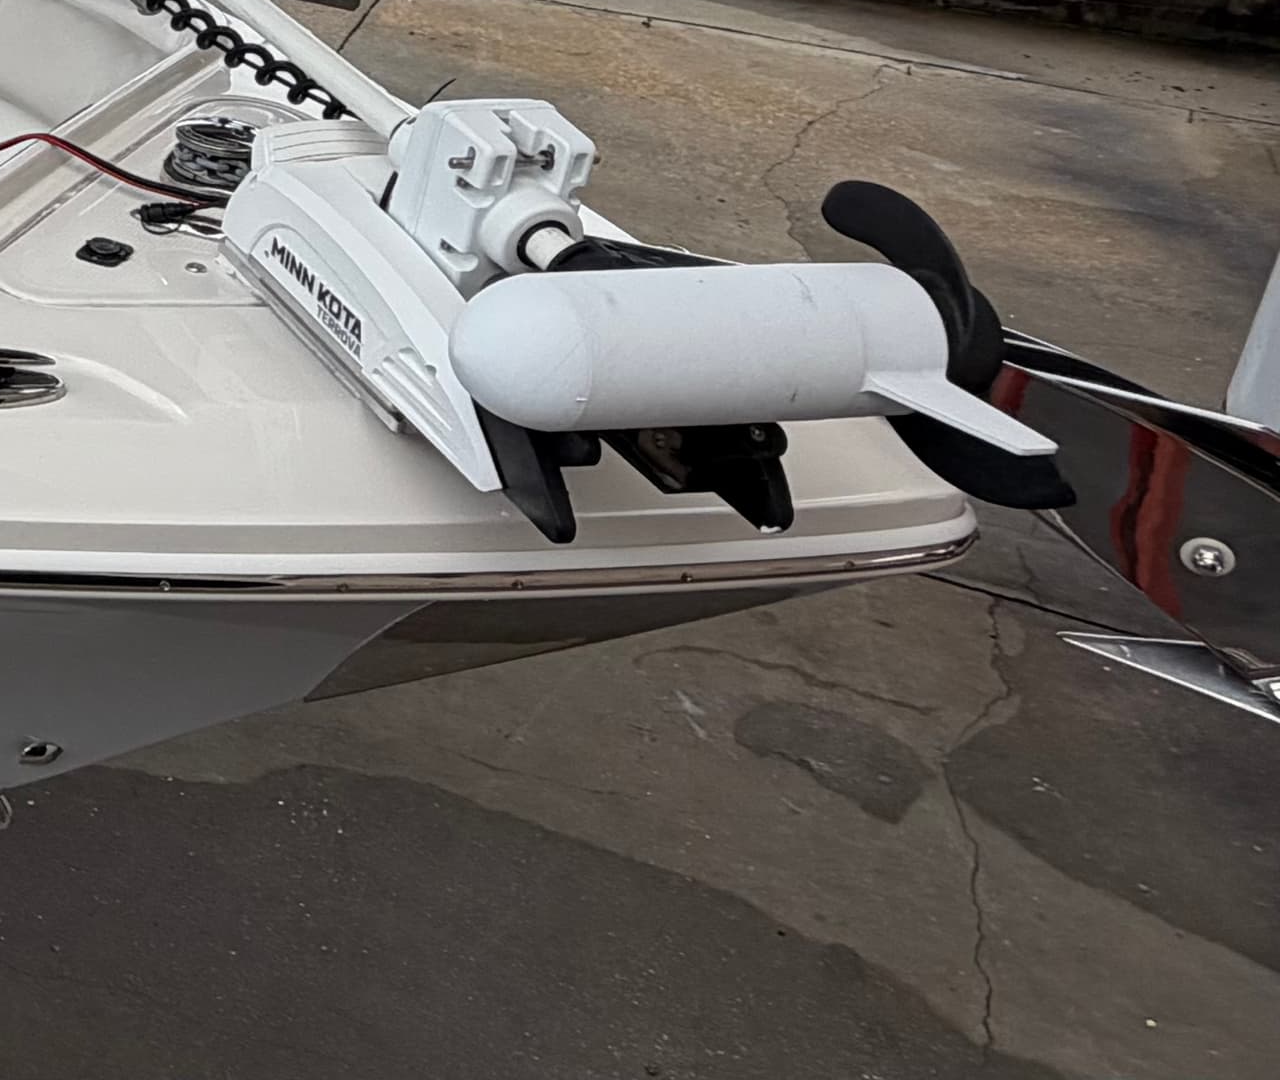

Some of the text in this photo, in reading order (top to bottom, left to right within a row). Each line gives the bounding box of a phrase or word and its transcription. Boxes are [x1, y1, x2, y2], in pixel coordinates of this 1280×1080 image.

[270, 236, 362, 344] MINN KOTA
[316, 304, 361, 359] TERROVA
